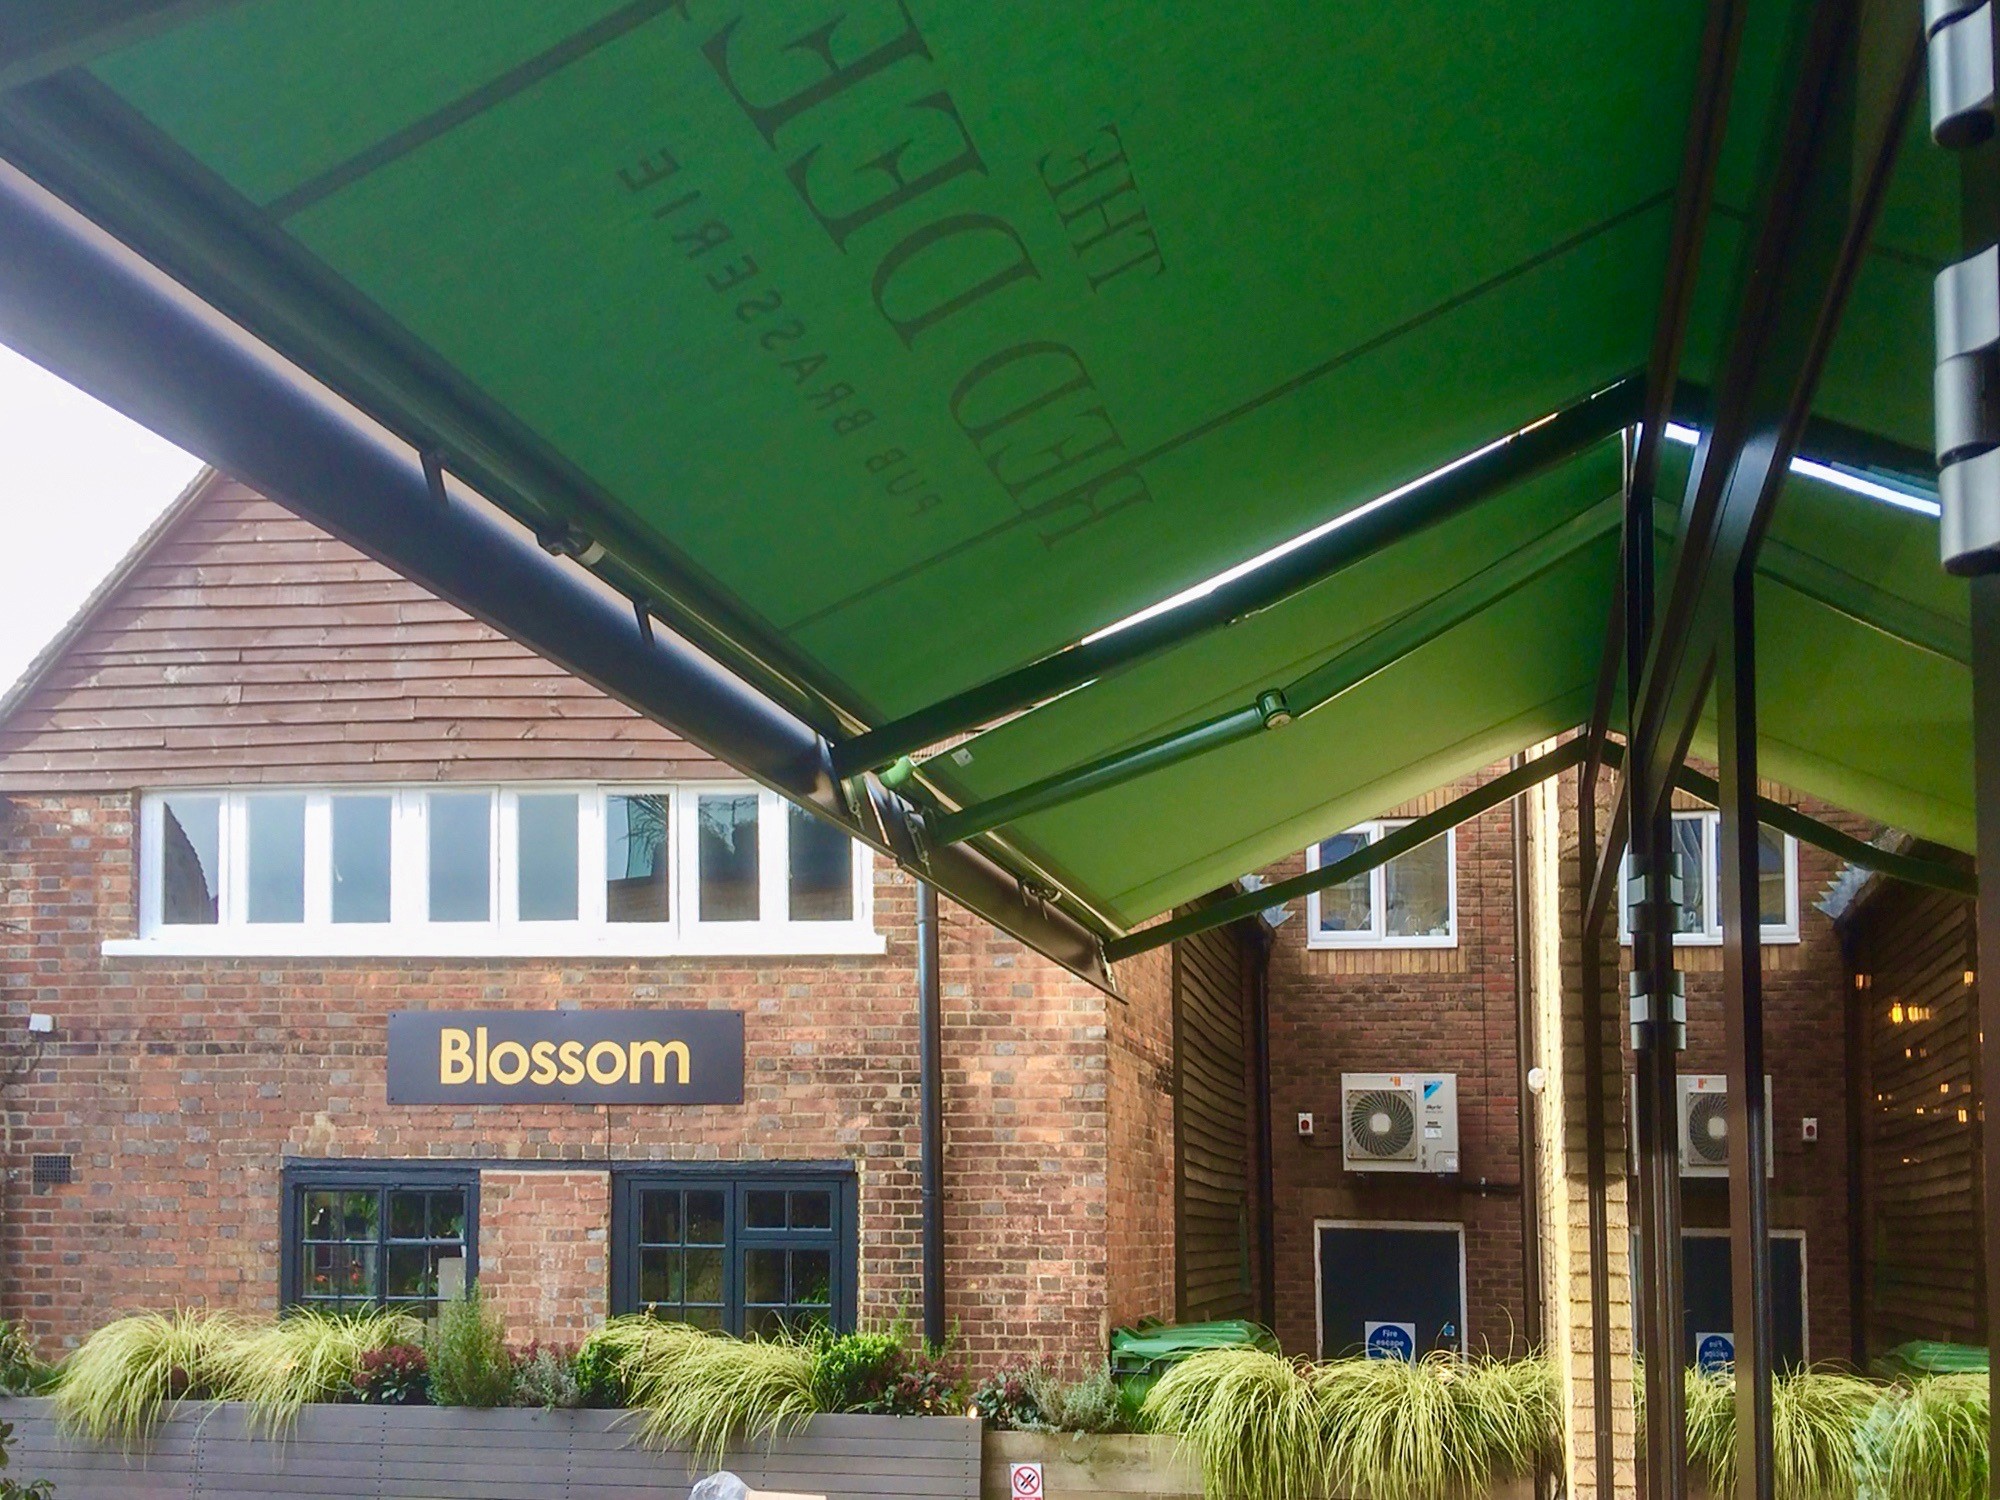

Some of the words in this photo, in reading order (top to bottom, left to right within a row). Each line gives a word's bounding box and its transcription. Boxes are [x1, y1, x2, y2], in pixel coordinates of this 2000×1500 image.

[440, 1026, 691, 1086] Blossom
[1382, 1329, 1398, 1338] Fire
[1376, 1339, 1404, 1348] escape
